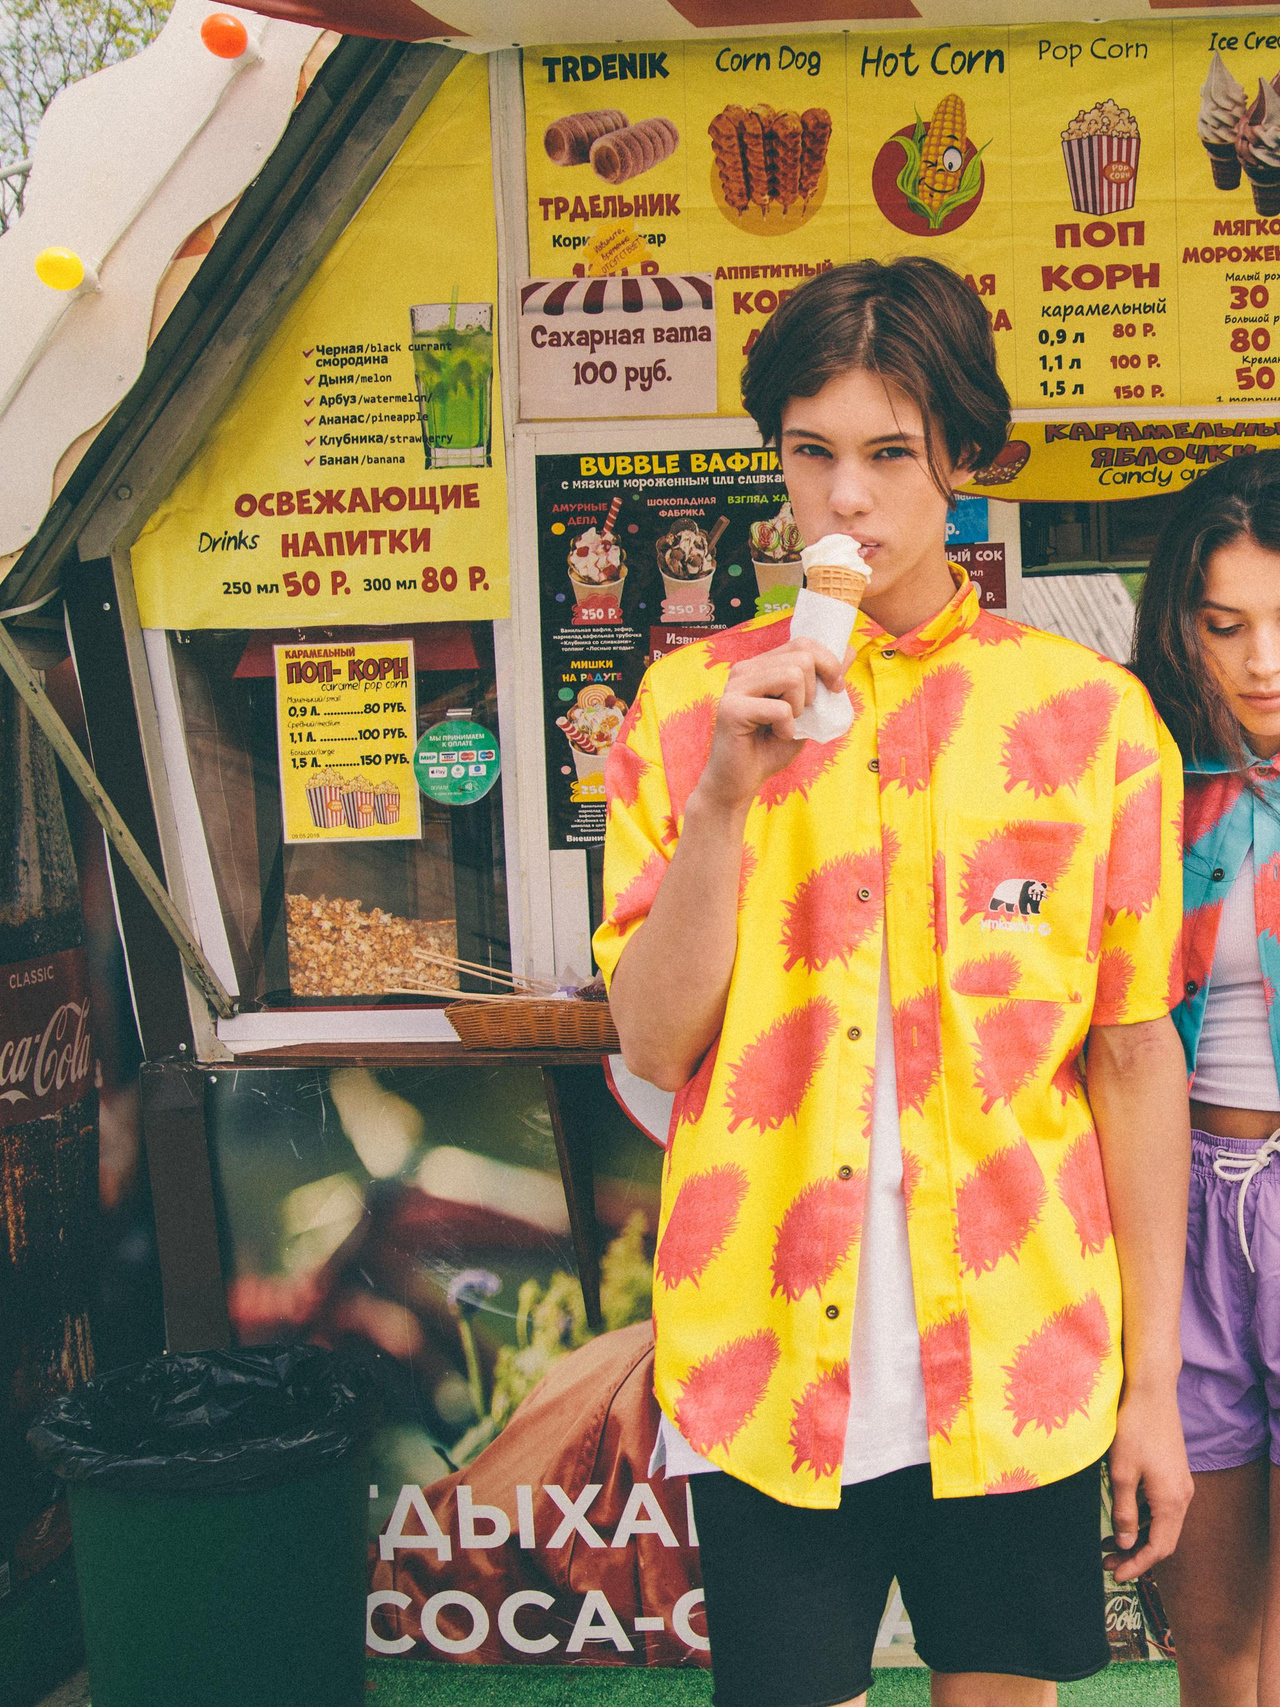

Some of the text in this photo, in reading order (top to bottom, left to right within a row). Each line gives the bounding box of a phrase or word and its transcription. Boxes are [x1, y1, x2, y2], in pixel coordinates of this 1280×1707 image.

[1208, 32, 1239, 51] Ice
[716, 46, 821, 75] Corn Dog
[861, 42, 1005, 79] Hot Corn
[1038, 37, 1148, 67] Pop Corn
[542, 52, 670, 83] TRDENIK
[539, 193, 681, 221] ТРДЕЛЬНИК
[1055, 221, 1145, 248] ПОП
[1041, 263, 1160, 292] КОРН
[1225, 271, 1259, 282] Малый
[1230, 285, 1270, 310] 30
[1041, 295, 1167, 322] карамельный
[1224, 313, 1269, 324] Большой
[530, 324, 711, 353] Сахарная вата
[1038, 323, 1156, 345] 0,9 80 Р.
[1230, 329, 1271, 352] 80
[316, 355, 388, 368] смородина
[1039, 354, 1161, 372] 1,1 100 Р.
[318, 372, 392, 387] Дыня/melon
[573, 357, 672, 391] 100 руб.
[1236, 367, 1276, 390] 50
[1040, 381, 1165, 399] 1,5 150 Р.
[580, 451, 783, 476] BUBBLE ВАФЛИ
[1091, 444, 1257, 469] ЯБЛОЧКИ
[572, 476, 734, 490] мягким мороженным или
[1099, 467, 1172, 487] Candy
[234, 483, 480, 518] ОСВЕЖАЮЩИЕ
[552, 503, 608, 513] АМУРНЫЕ
[647, 497, 716, 506] ШОКОЛАДНАЯ
[728, 495, 768, 504] ВЗГЛЯД
[568, 517, 597, 526] ДЕЛА
[659, 508, 705, 517] ФАБРИКА
[198, 529, 260, 553] Drinks
[281, 528, 431, 558] НАПИТКИ
[976, 551, 1002, 560] СОК
[222, 566, 490, 597] 250 мл 50 Р. 300 мл 80 Р.
[582, 609, 604, 620] 250
[668, 605, 692, 614] 250
[285, 647, 355, 659] КАРАМЕЛЬНЫЙ
[286, 657, 408, 684] ПОП- КОРН
[571, 660, 613, 669] МИШКИ
[321, 681, 360, 691] caramel
[364, 683, 382, 692] pop
[562, 673, 622, 682] НА РАДУГЕ
[288, 703, 406, 717] 0,9 РУБ.
[290, 728, 407, 743] 1,1 РУБ.
[292, 754, 409, 769] 1,5 РУБ.
[10, 966, 54, 988] CLASSIC
